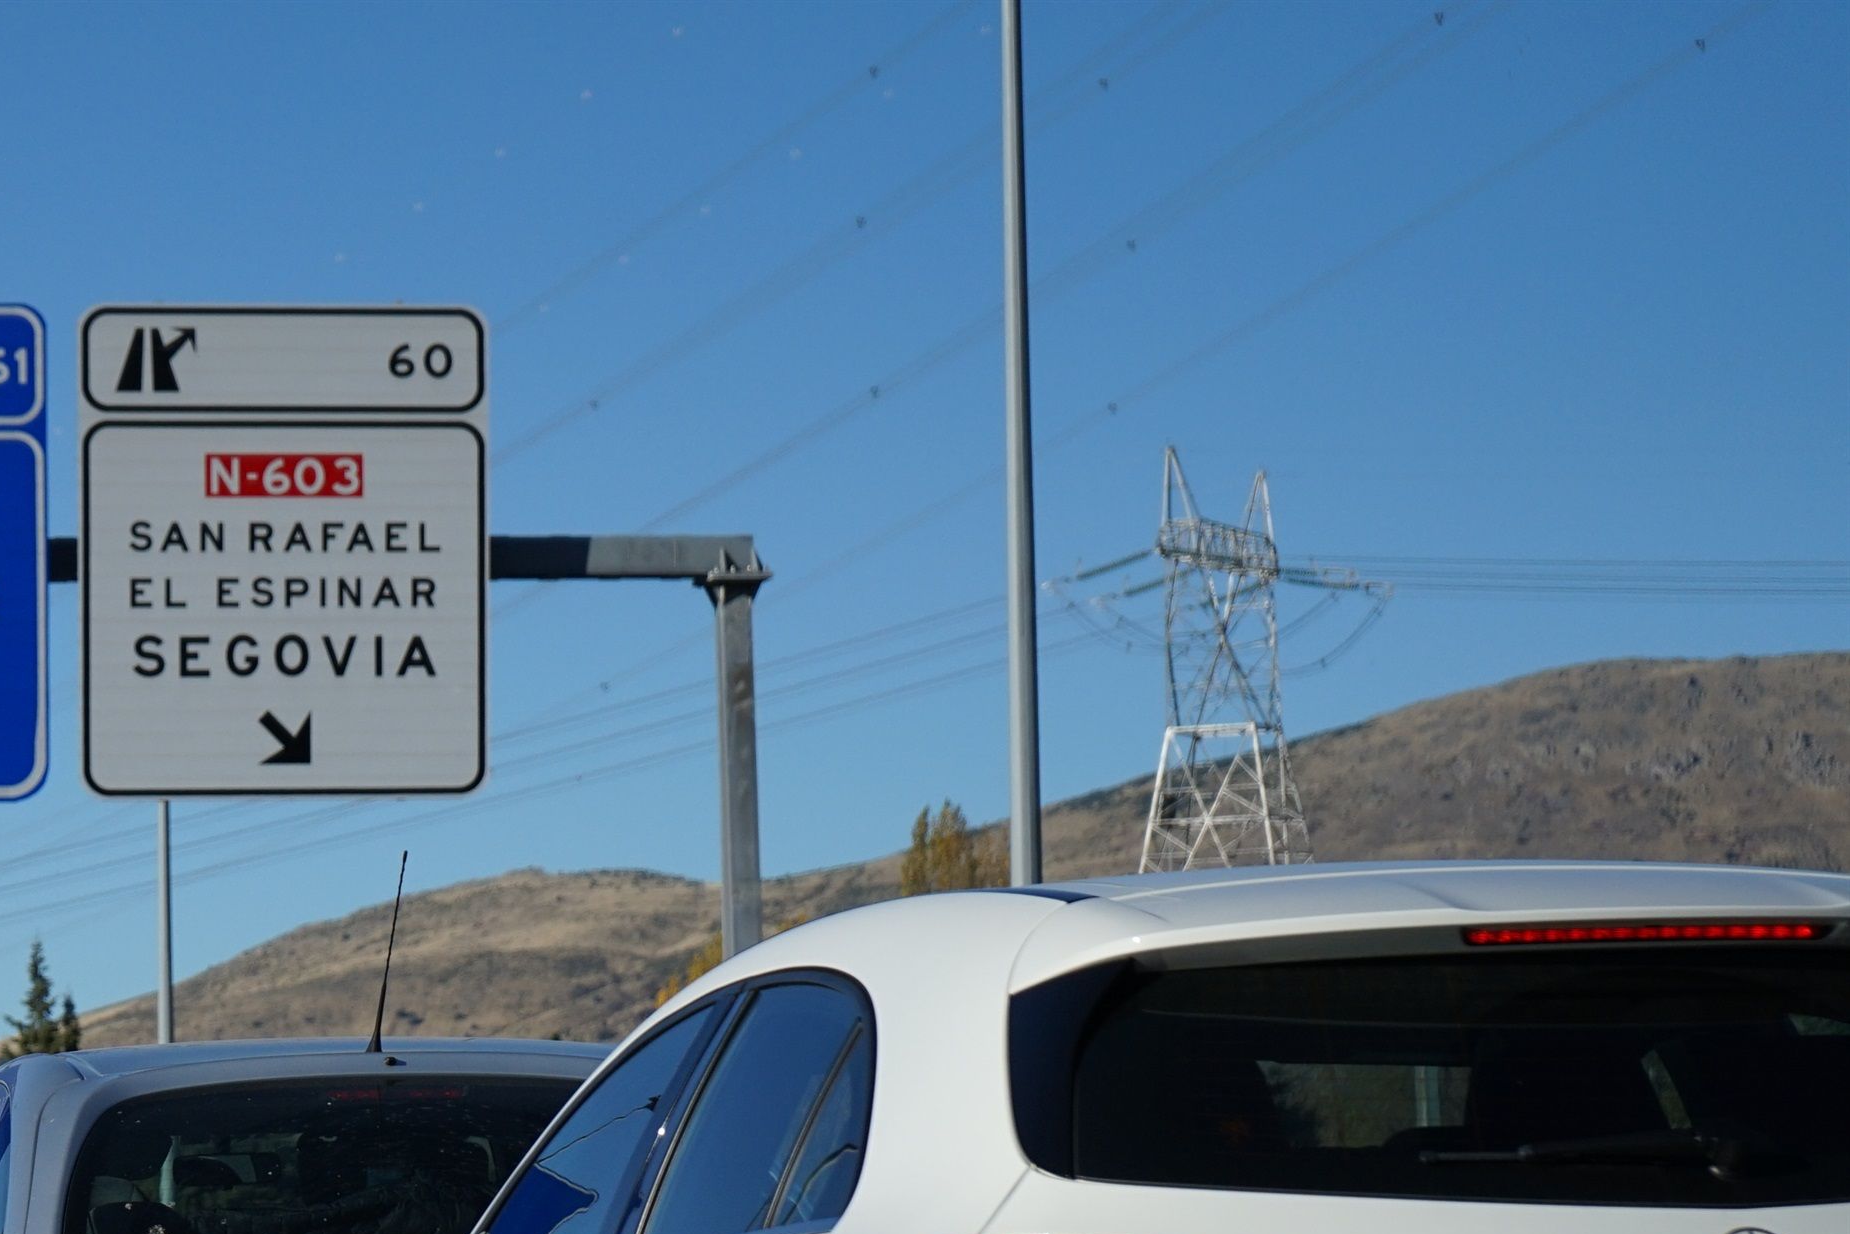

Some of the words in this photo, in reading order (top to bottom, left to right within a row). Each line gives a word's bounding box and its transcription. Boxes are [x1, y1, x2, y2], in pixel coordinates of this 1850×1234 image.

[388, 343, 454, 380] 60
[210, 457, 360, 496] N-603
[128, 519, 225, 554] SAN
[248, 519, 442, 554] RAFAEL
[129, 577, 187, 609] EL
[216, 576, 436, 609] ESPINAR
[133, 633, 437, 679] SEGOVIA
